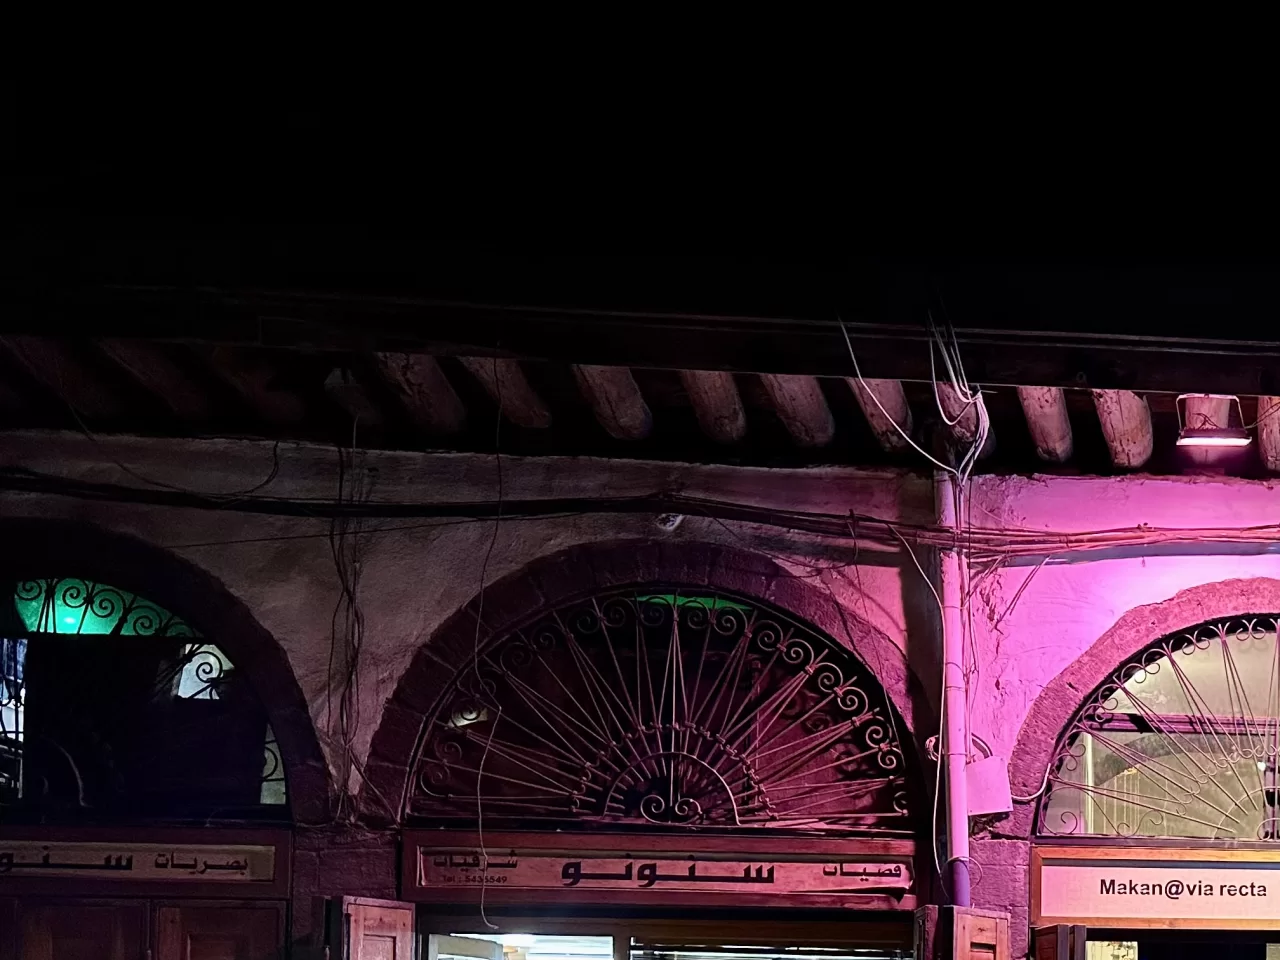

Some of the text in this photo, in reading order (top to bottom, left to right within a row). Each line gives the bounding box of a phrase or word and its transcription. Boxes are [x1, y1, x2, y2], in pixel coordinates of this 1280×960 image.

[155, 851, 248, 876] بصريات
[433, 850, 518, 872] شرقيات
[561, 853, 775, 888] سنونو
[1100, 879, 1267, 899] Makan@via recta
